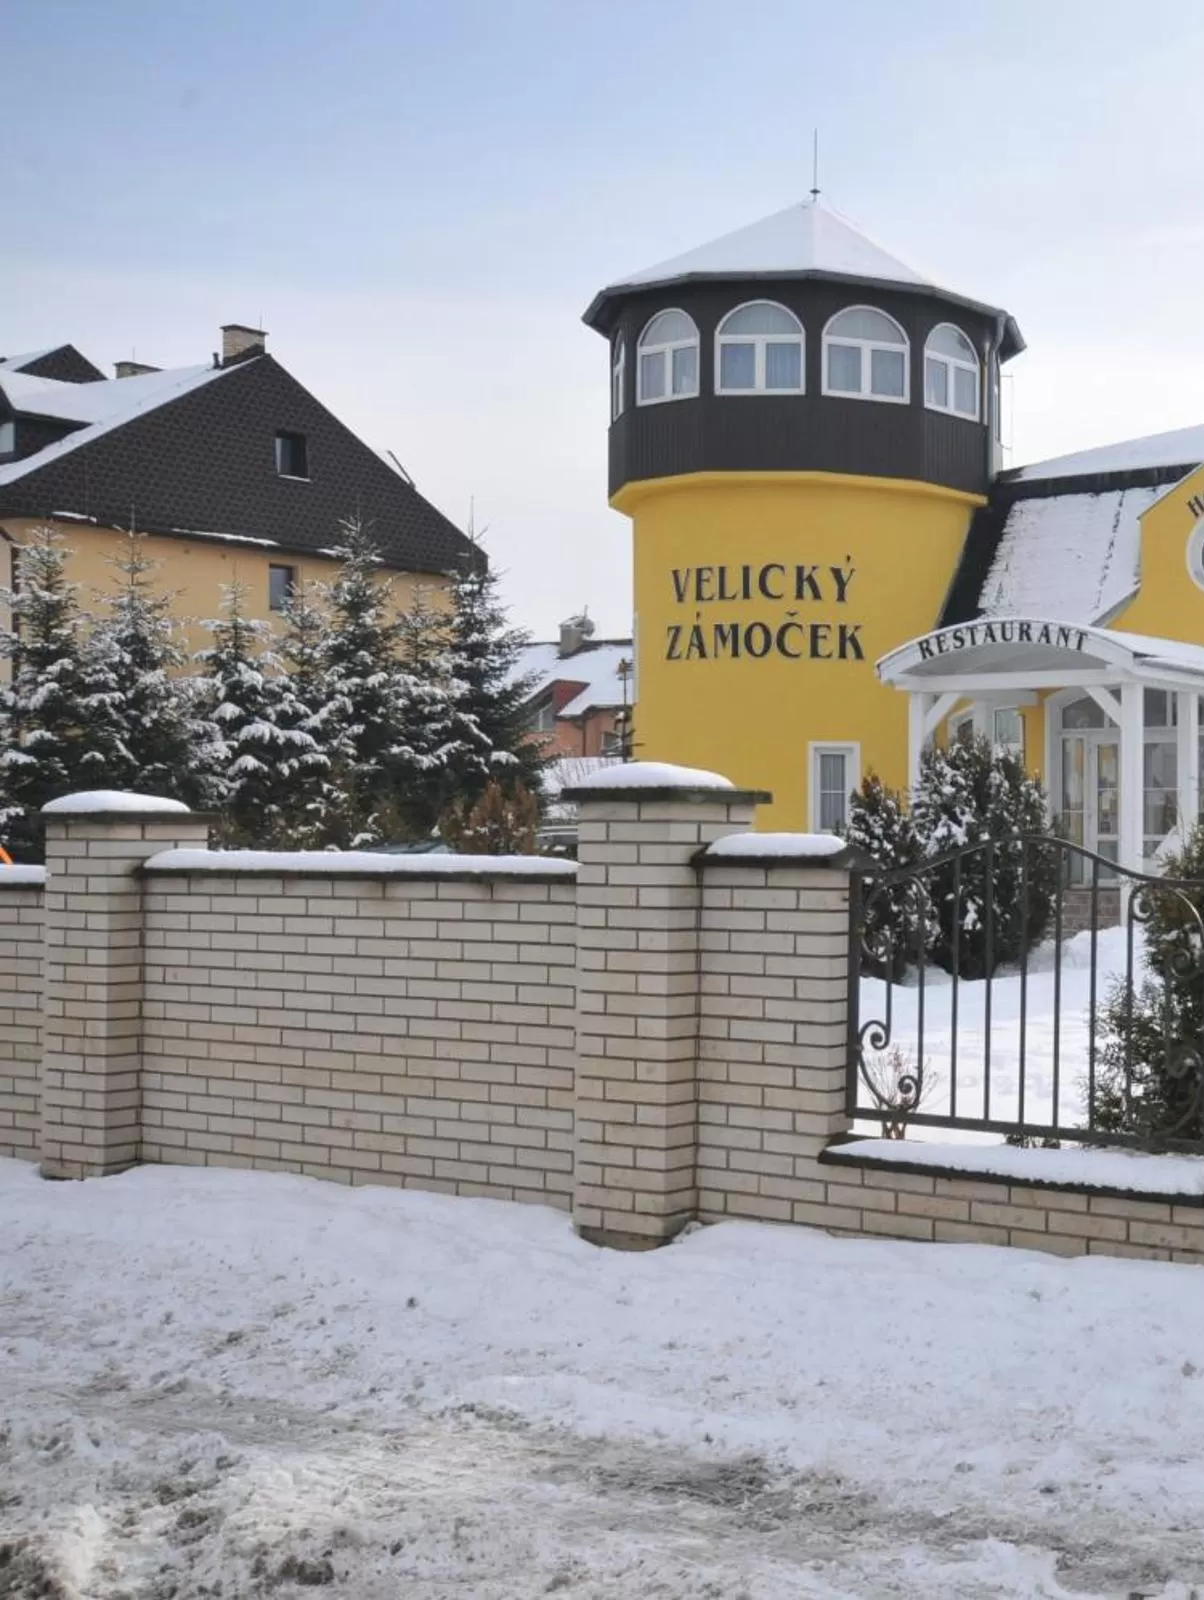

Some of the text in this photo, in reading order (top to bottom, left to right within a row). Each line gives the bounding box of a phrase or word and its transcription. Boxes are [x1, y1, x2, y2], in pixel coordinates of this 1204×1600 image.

[671, 551, 856, 603] VELICKÝ
[665, 611, 865, 661] ZÁMOČEK
[916, 620, 1089, 661] RESTAURANT
